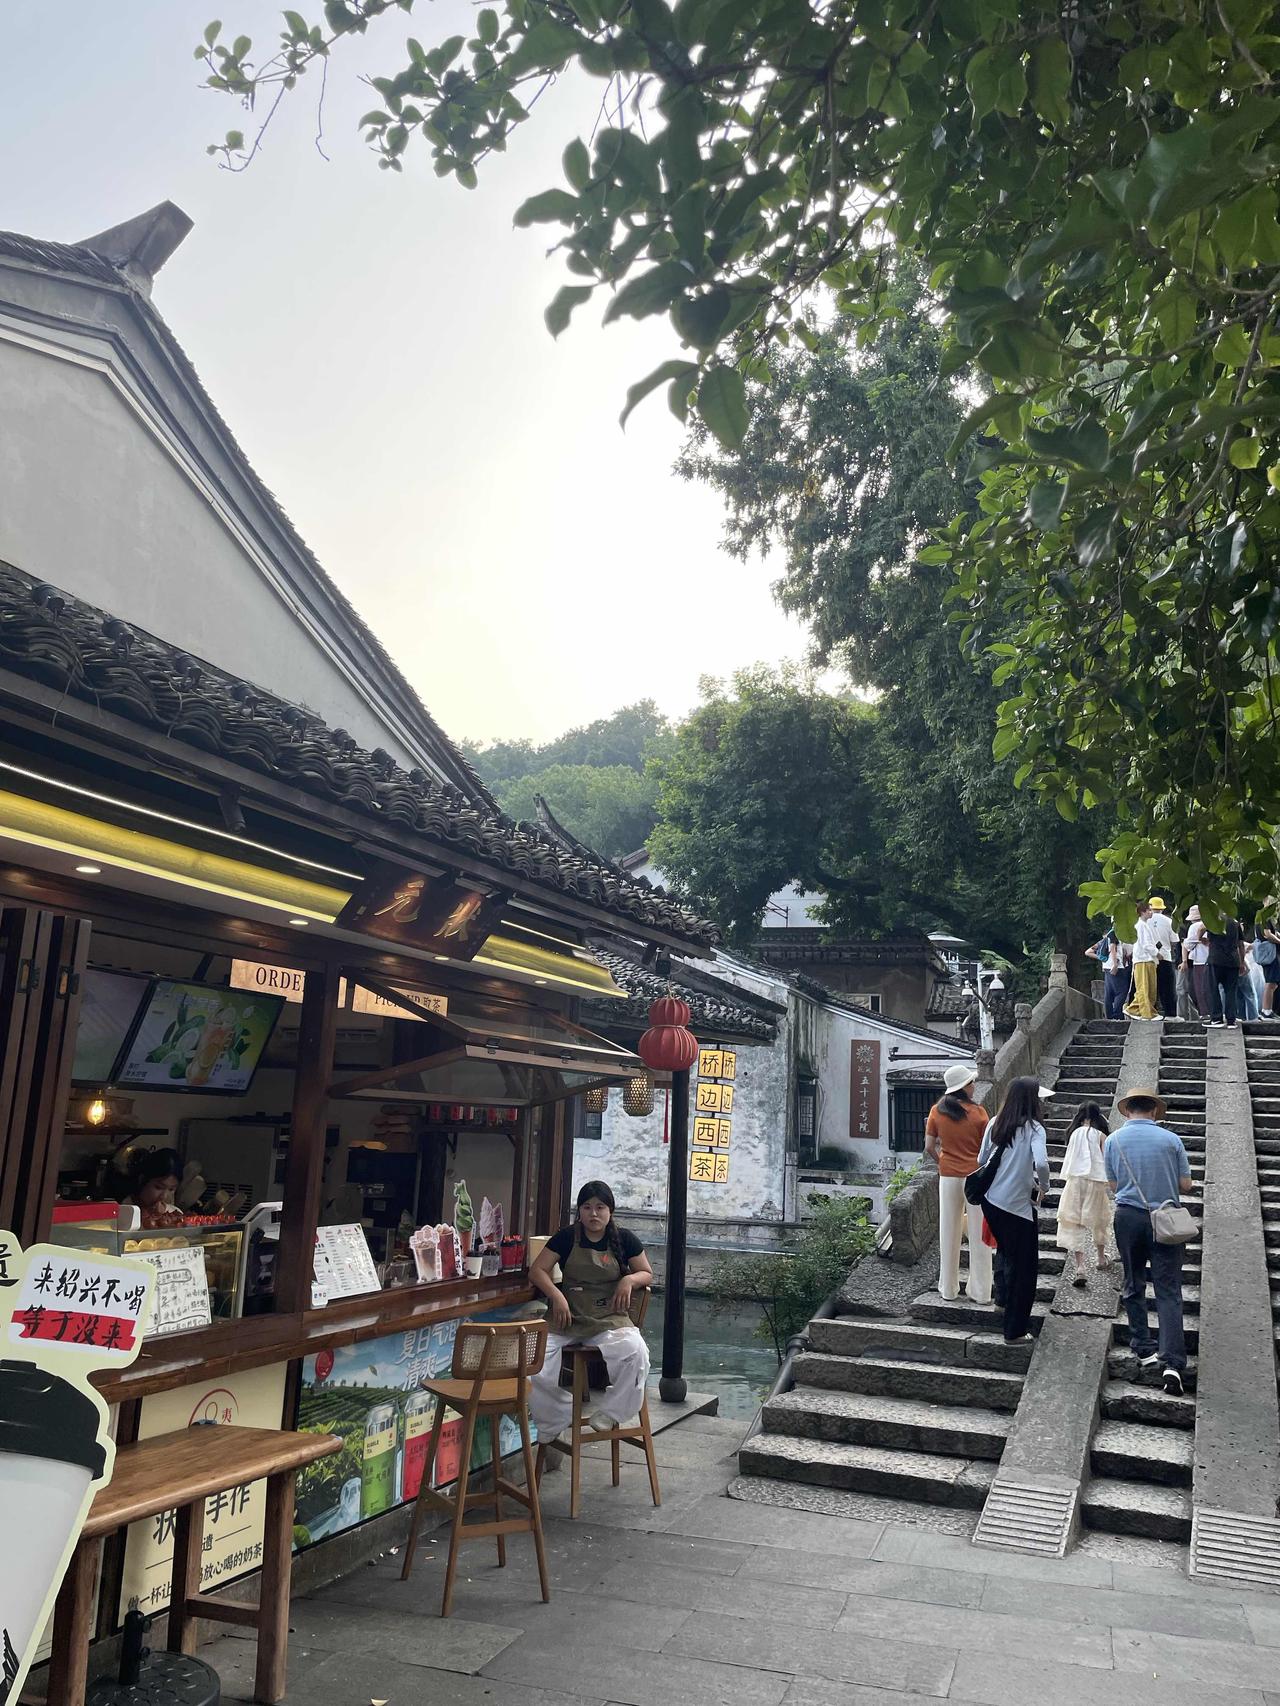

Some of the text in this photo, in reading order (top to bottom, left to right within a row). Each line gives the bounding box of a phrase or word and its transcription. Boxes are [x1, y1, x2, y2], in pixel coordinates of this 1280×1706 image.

[256, 966, 304, 992] ORDE
[34, 1261, 146, 1315] 来绍兴不喝
[23, 1304, 122, 1351] 等于没来
